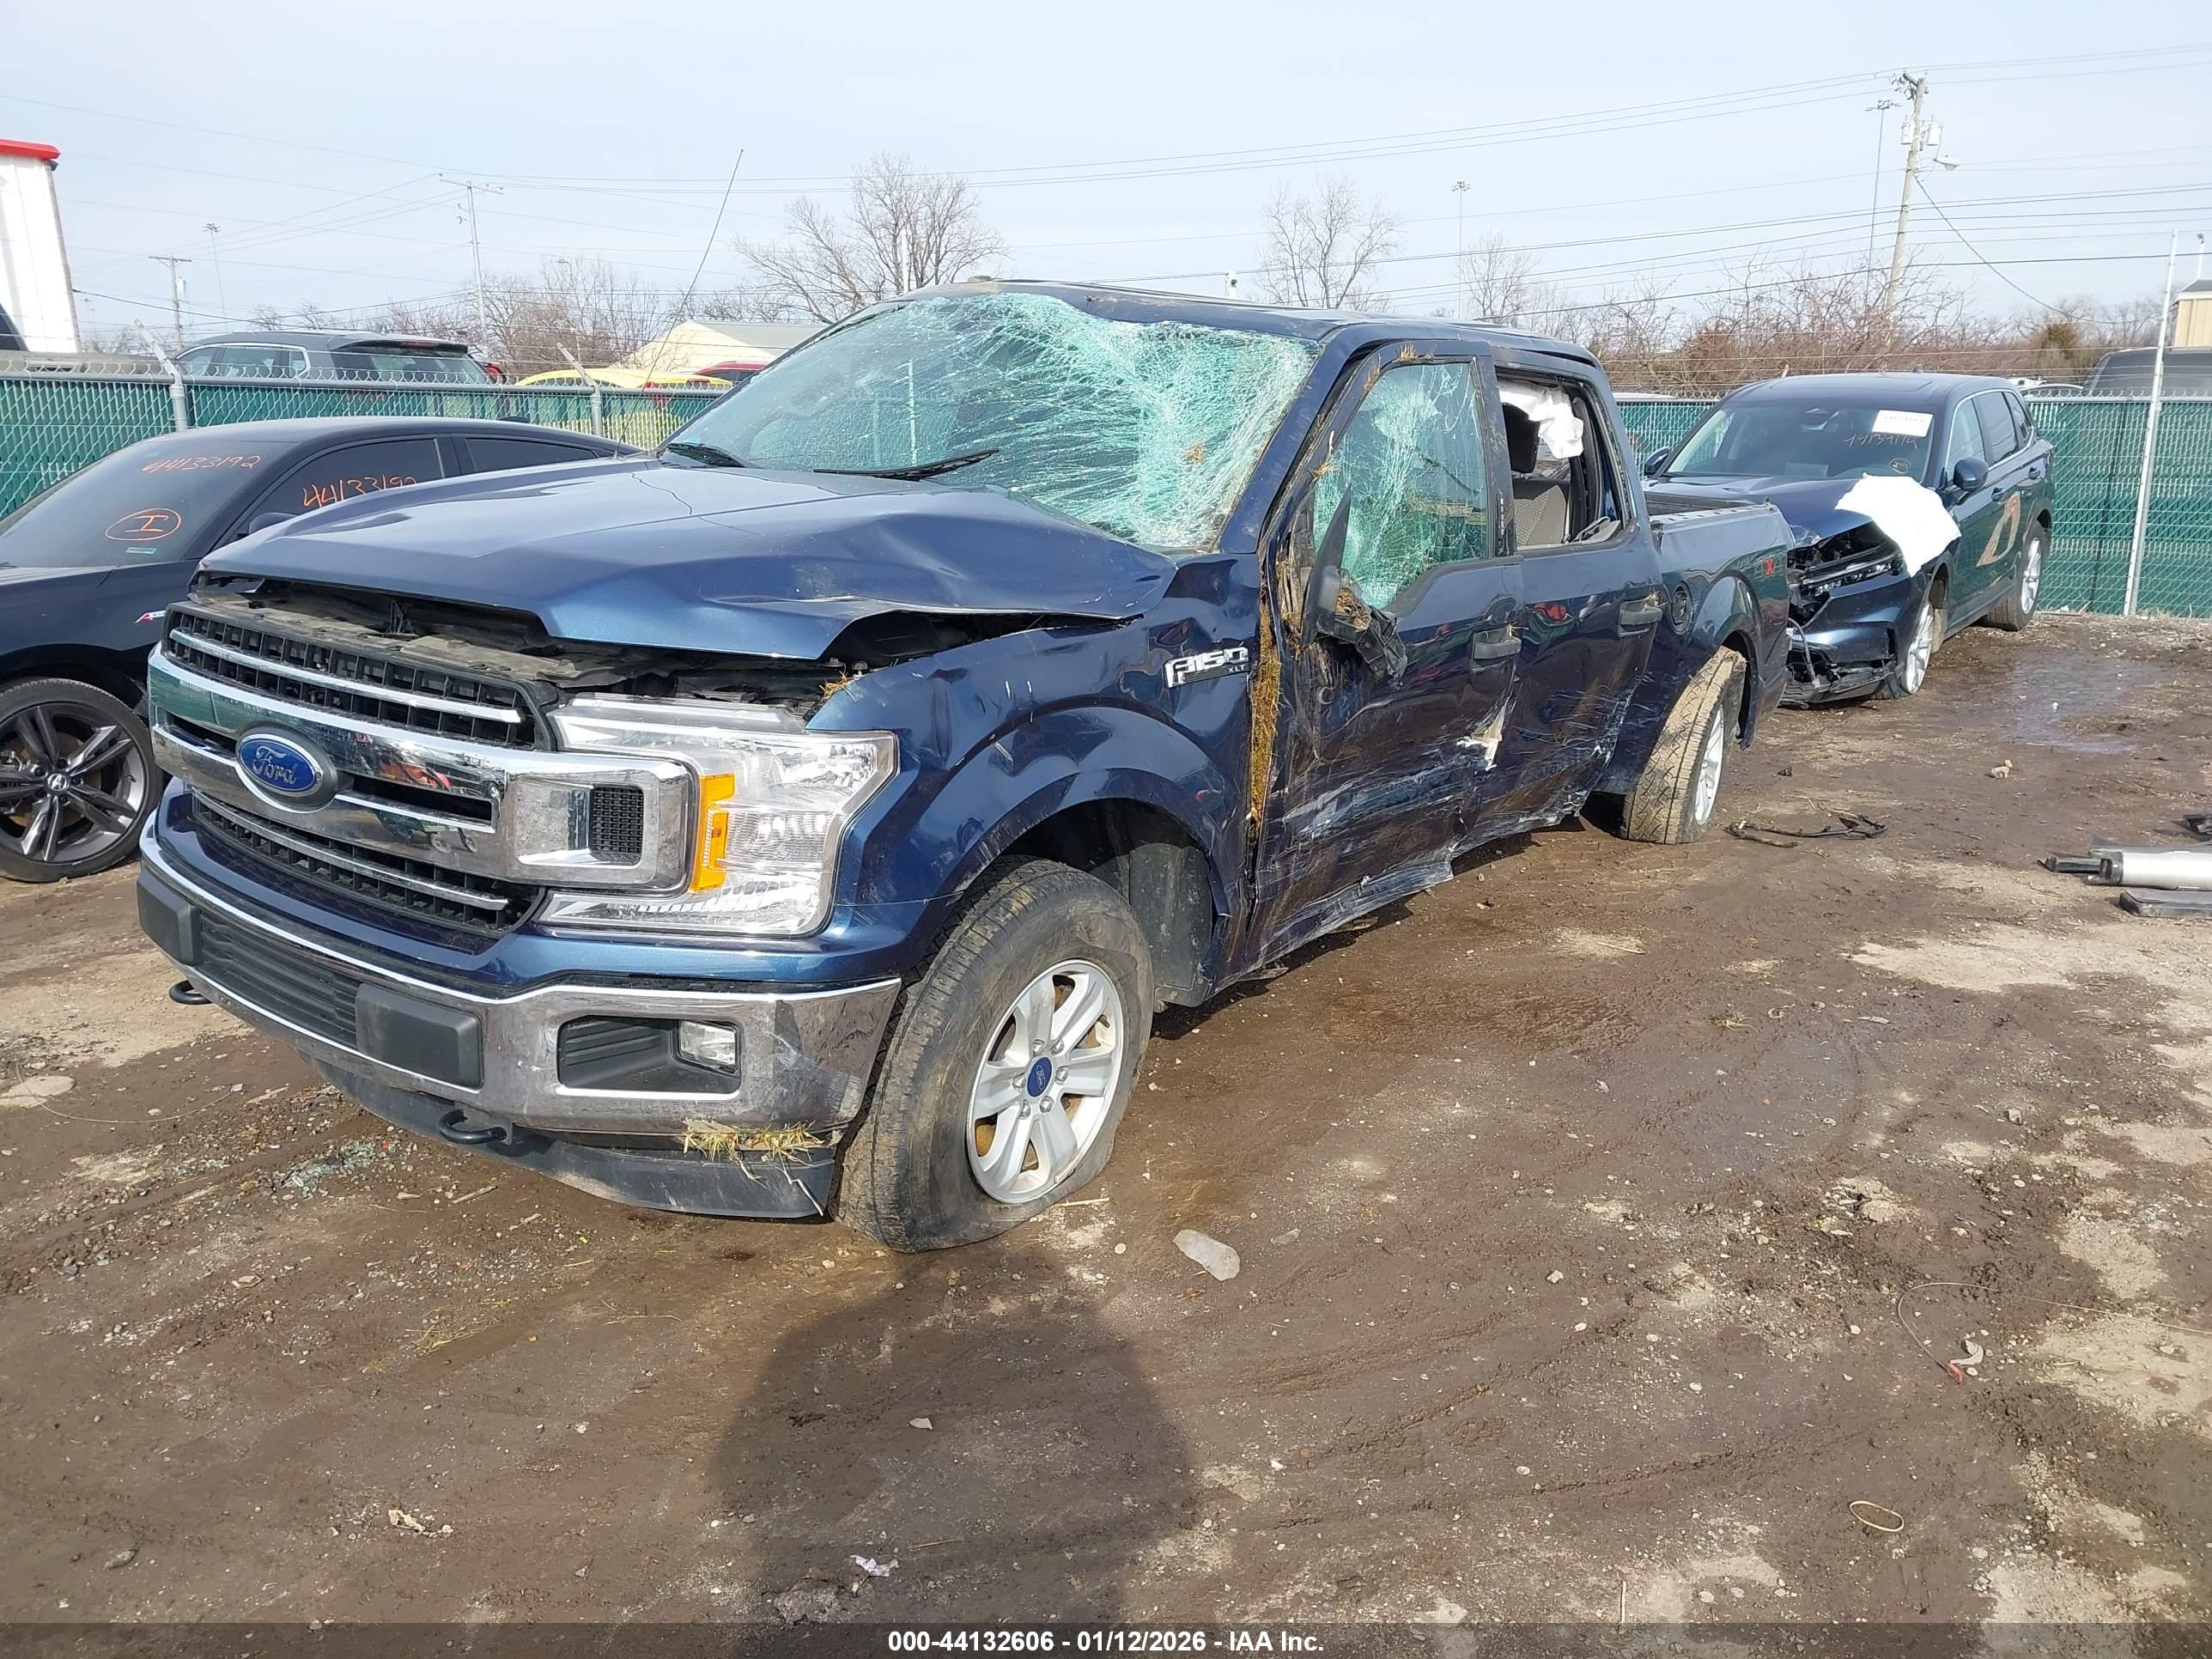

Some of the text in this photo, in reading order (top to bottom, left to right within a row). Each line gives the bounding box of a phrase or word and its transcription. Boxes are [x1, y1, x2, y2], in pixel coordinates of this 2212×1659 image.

[142, 455, 261, 473] 44133192
[1228, 664, 1246, 673] XLT
[253, 745, 297, 784] Ford
